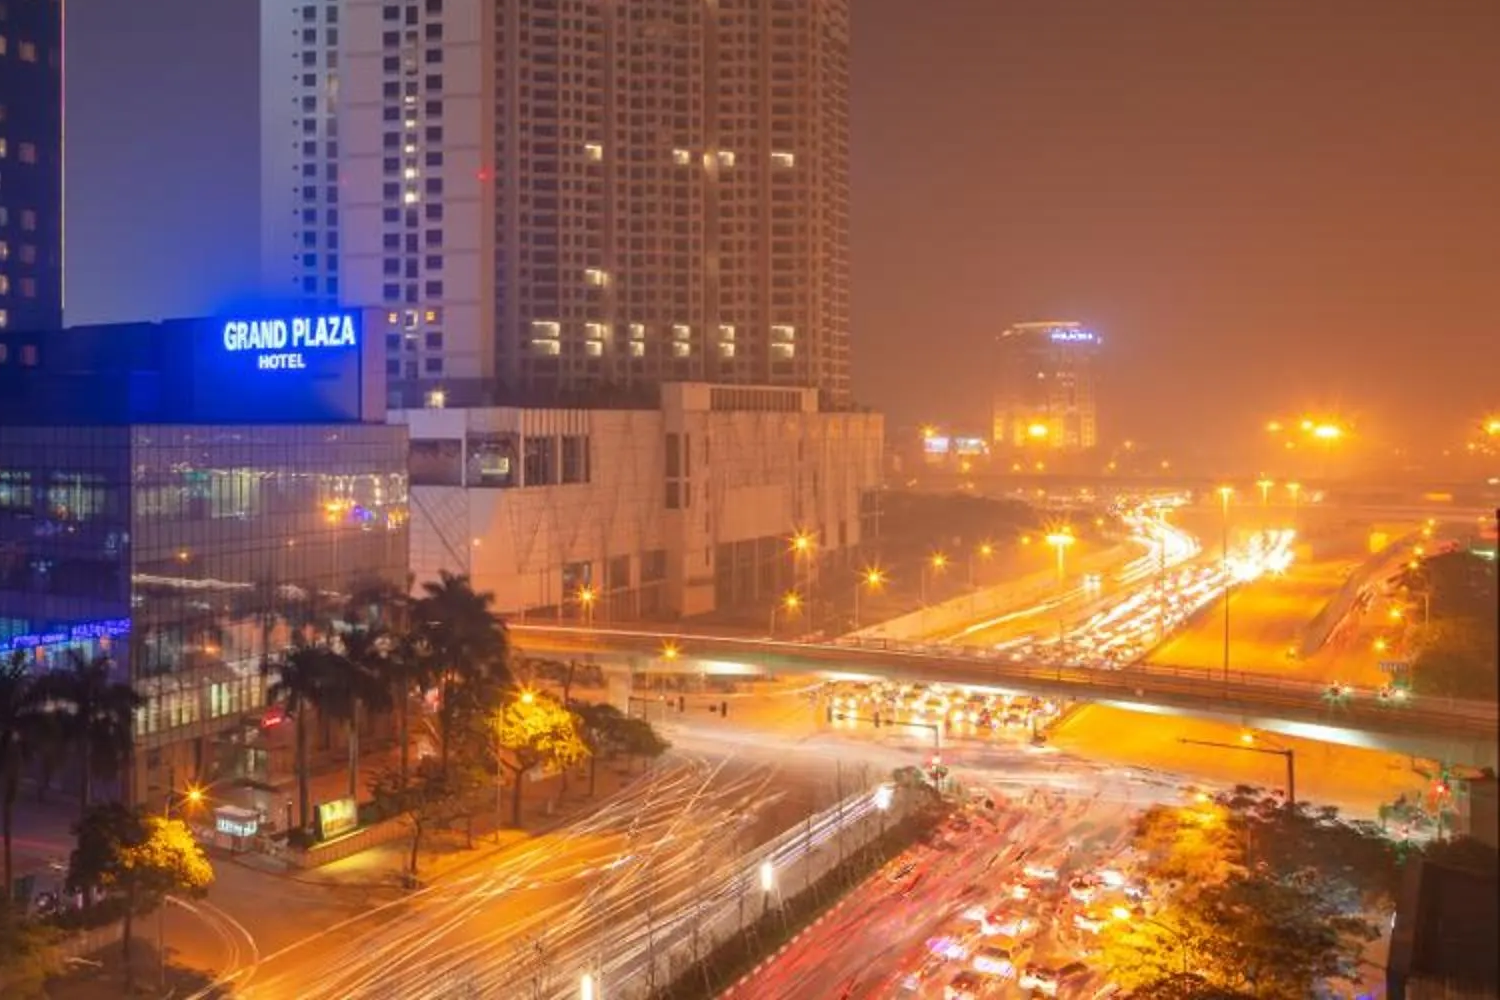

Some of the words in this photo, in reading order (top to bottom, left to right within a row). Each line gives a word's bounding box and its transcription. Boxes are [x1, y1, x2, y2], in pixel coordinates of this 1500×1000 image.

[223, 319, 288, 351] GRAND
[292, 315, 356, 347] PLAZA
[258, 353, 307, 370] HOTEL
